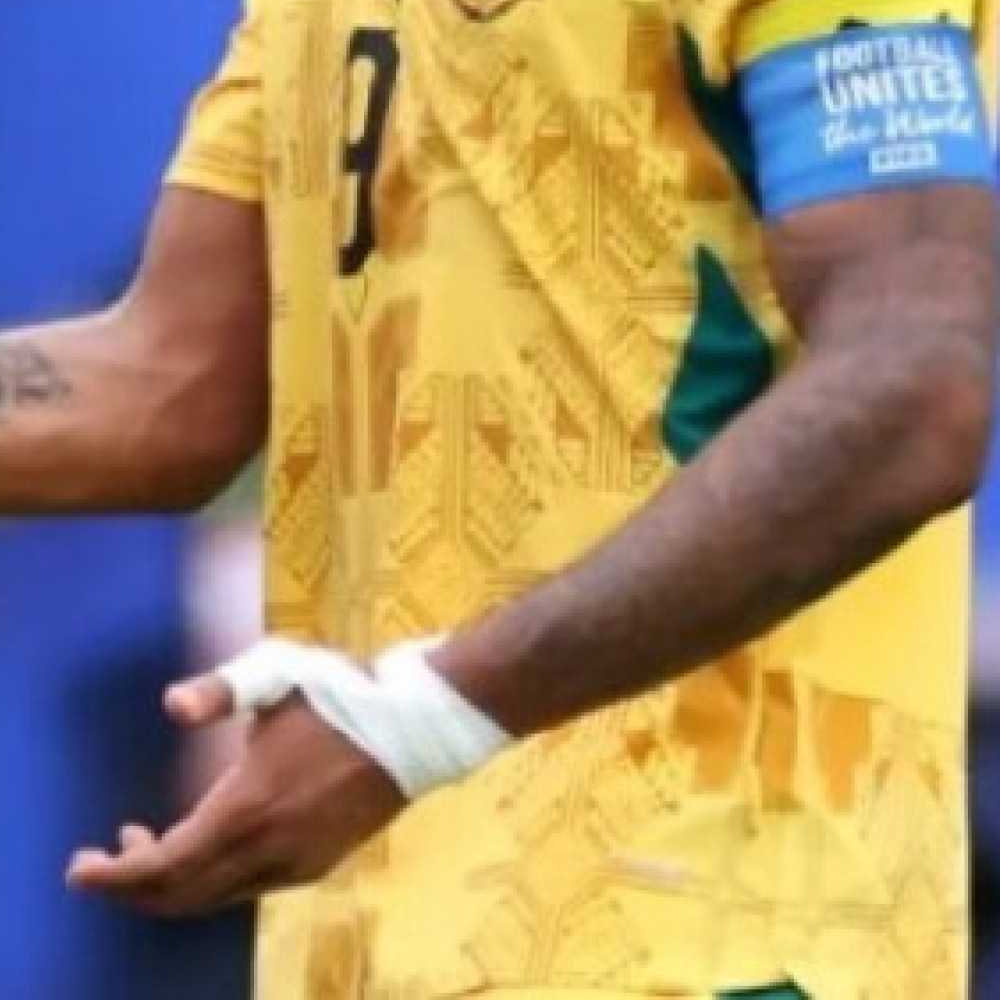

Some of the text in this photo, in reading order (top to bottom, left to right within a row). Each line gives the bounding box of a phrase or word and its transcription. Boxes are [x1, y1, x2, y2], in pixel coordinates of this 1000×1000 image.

[815, 36, 956, 75] FOOTBALL
[821, 62, 968, 114] UNITES
[338, 26, 401, 277] 9
